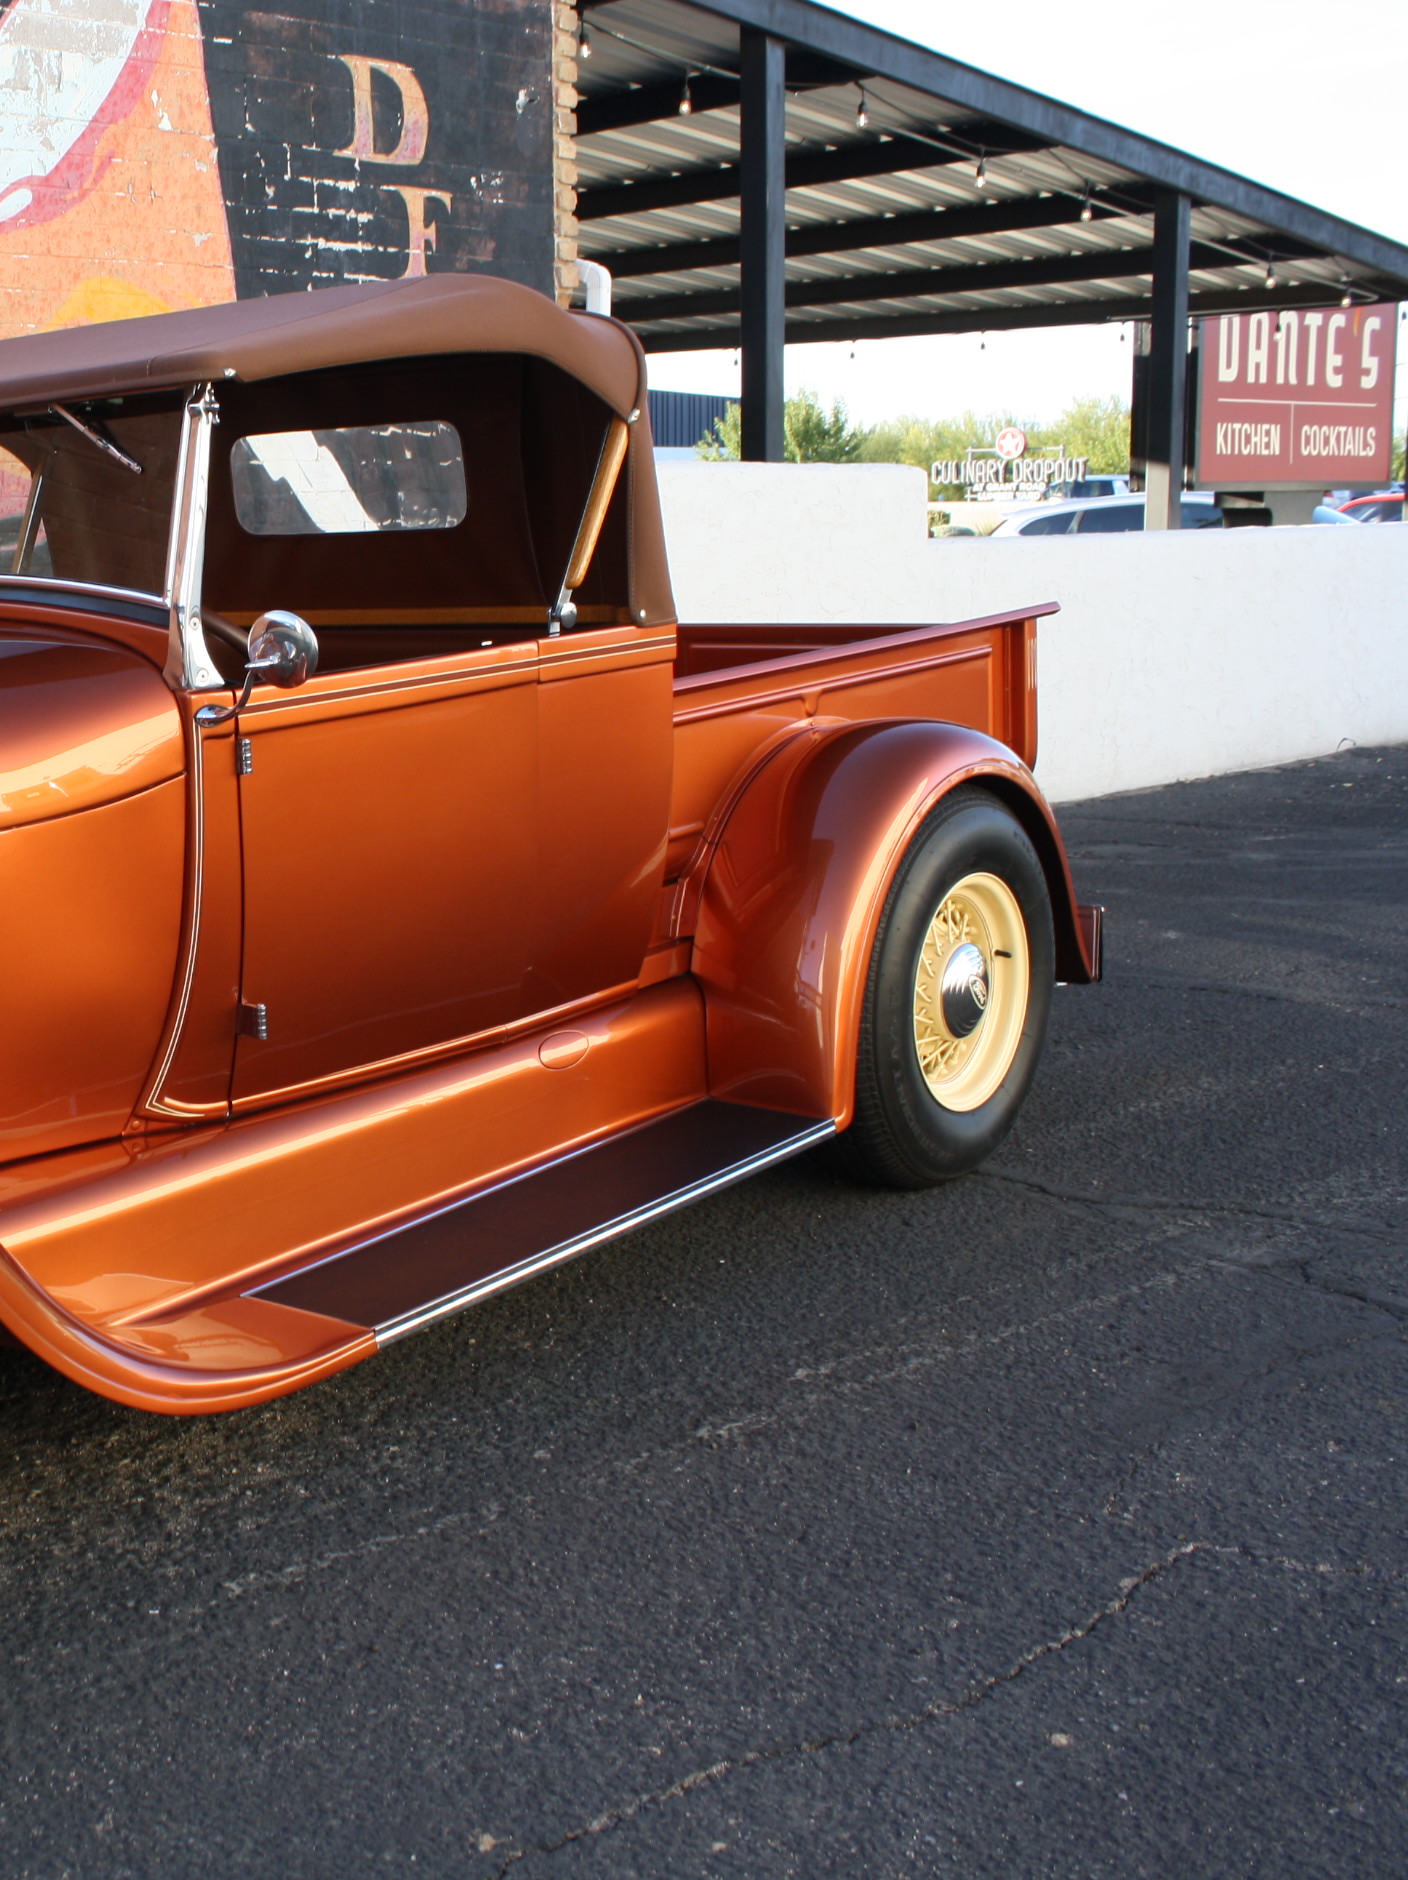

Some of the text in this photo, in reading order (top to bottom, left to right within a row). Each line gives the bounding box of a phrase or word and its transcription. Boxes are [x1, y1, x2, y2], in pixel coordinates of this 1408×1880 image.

[333, 54, 430, 165] D
[1216, 422, 1376, 457] KITCHEN COCKTAILS
[931, 458, 1088, 484] CULINARY DROPOUT
